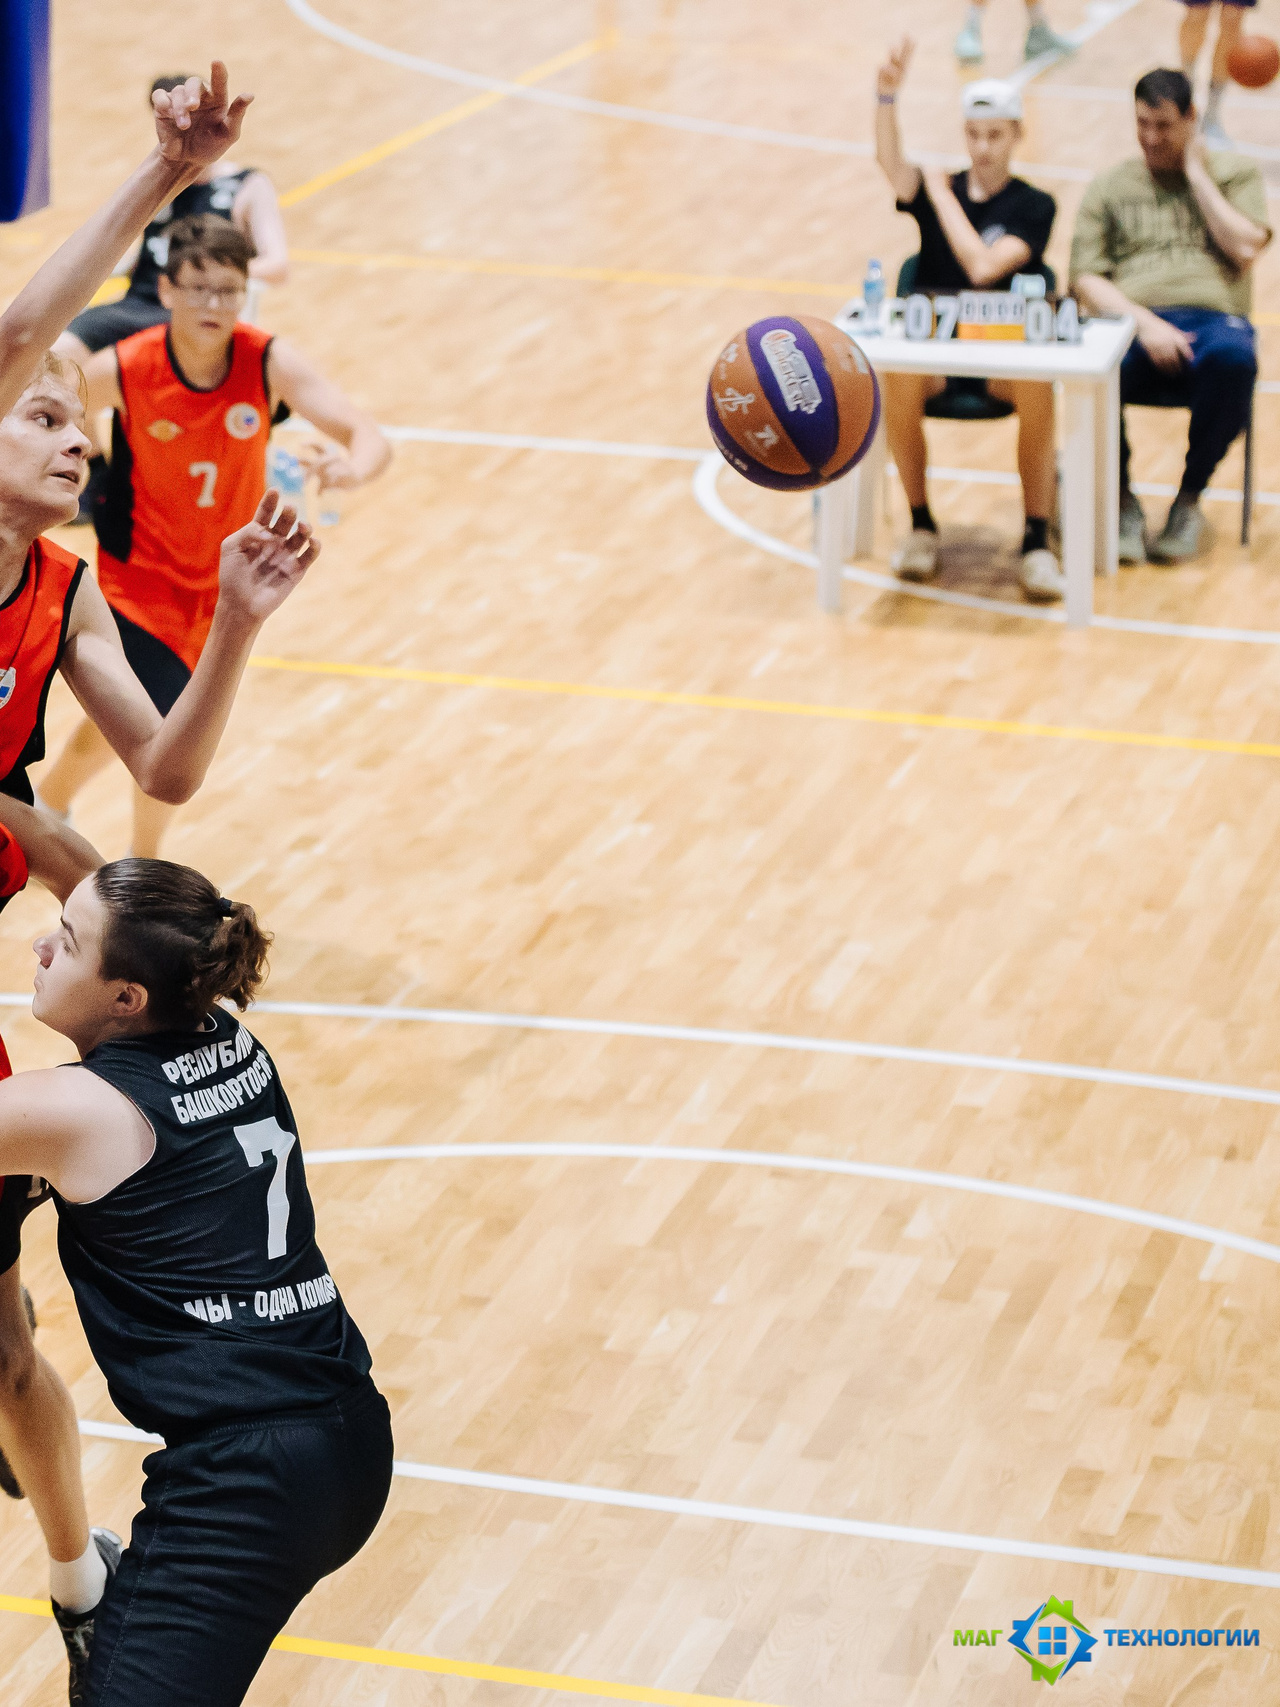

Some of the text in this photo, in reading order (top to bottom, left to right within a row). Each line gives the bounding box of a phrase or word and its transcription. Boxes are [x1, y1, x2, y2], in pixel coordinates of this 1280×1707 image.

[188, 460, 218, 509] 7
[233, 1115, 297, 1261] 7
[183, 1293, 233, 1324] МЫ
[254, 1290, 300, 1323] ОДНА
